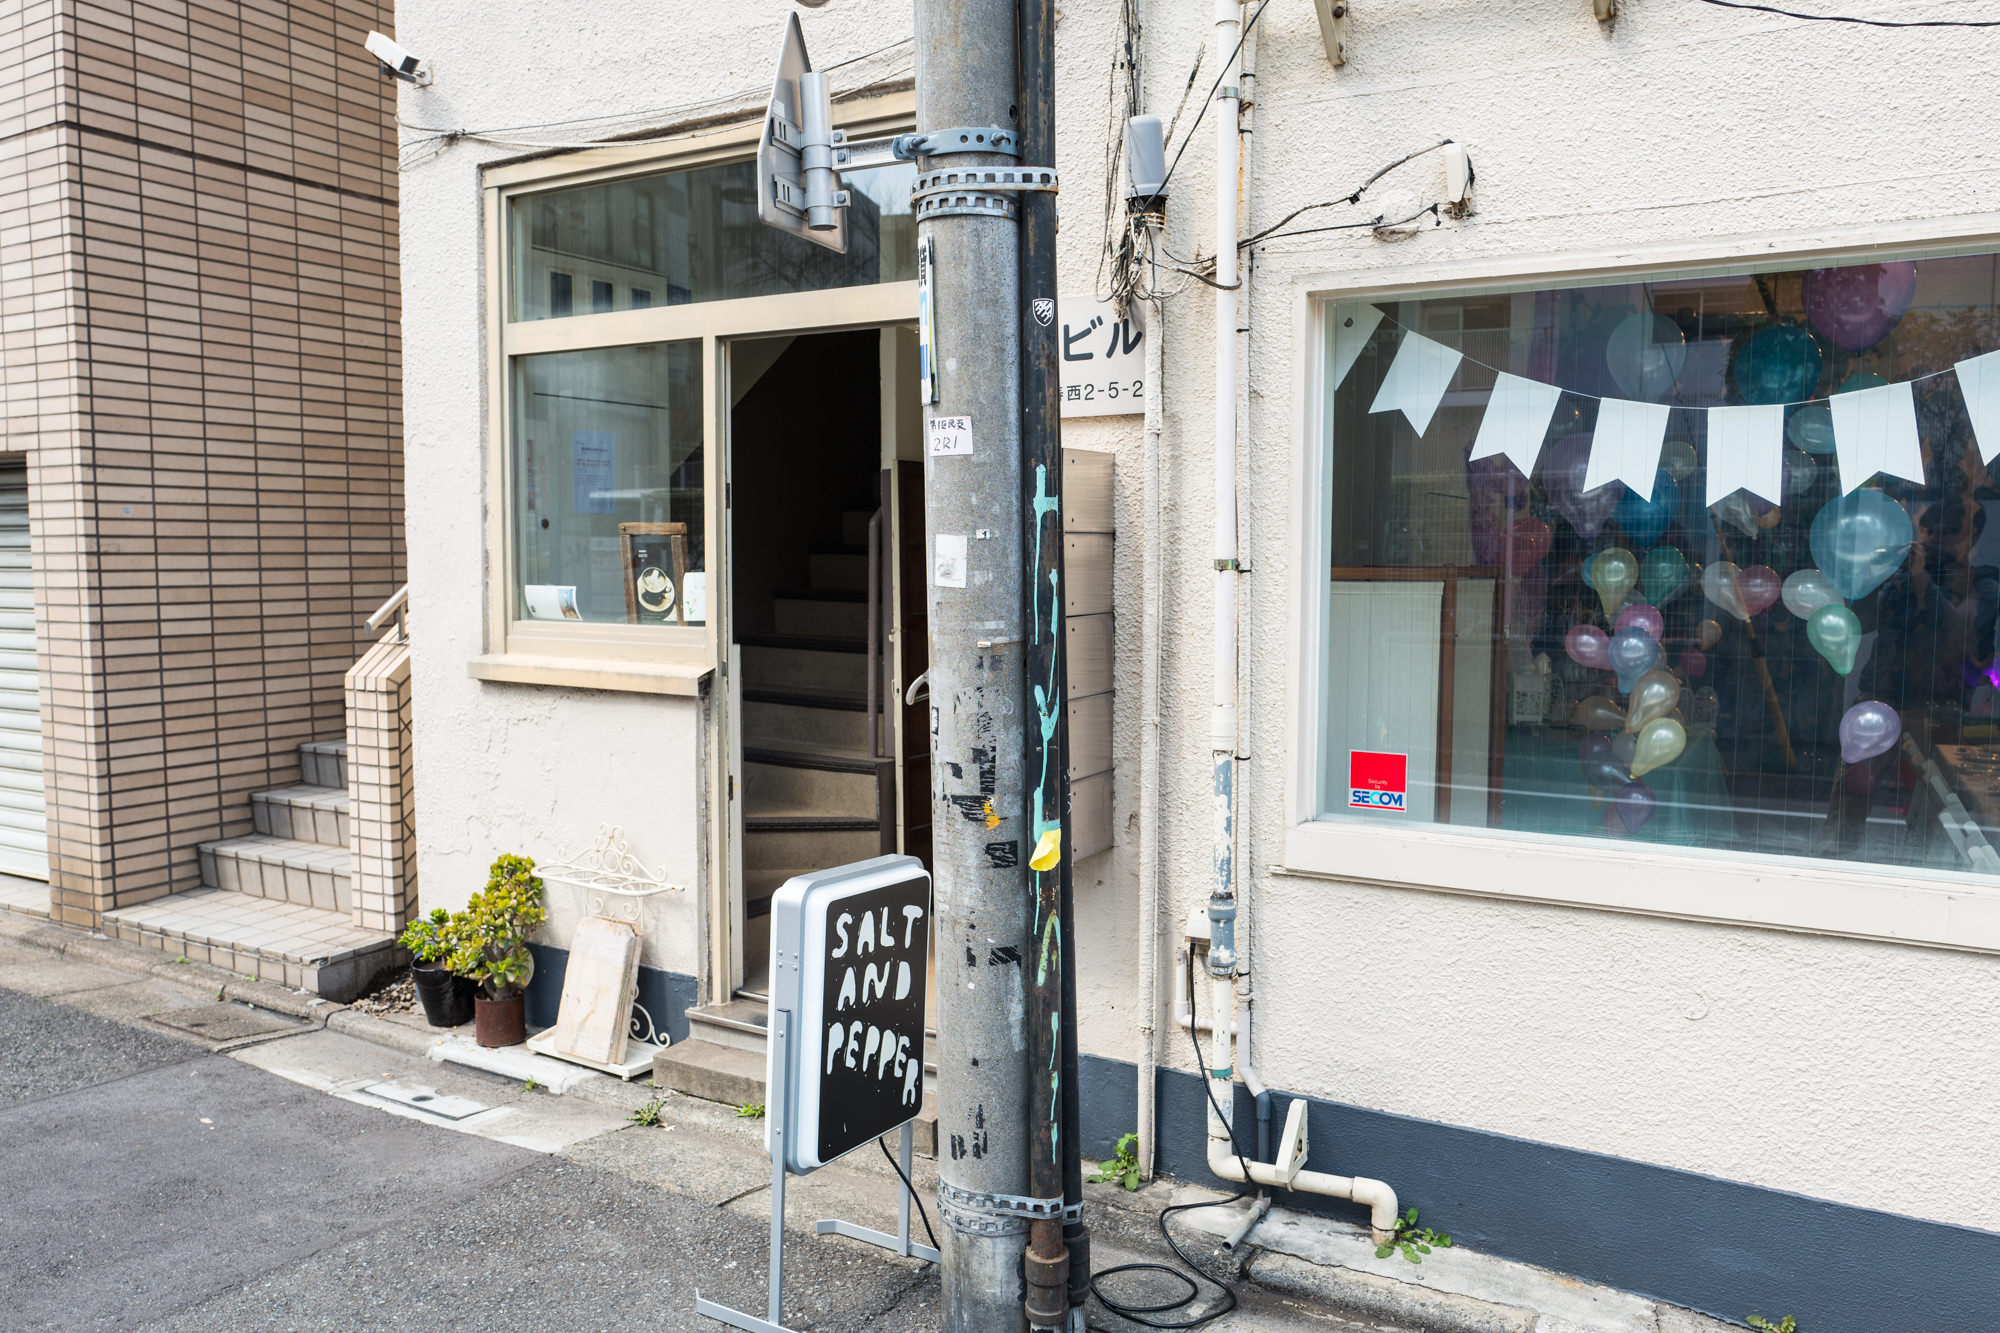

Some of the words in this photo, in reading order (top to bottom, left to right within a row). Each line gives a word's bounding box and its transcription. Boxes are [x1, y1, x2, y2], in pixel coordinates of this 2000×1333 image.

[1063, 315, 1143, 362] ビル
[1352, 790, 1403, 807] SECOM
[1368, 778, 1388, 786] Security
[832, 905, 924, 959] SALT
[837, 961, 912, 1011] AND
[826, 1020, 919, 1106] PEPPER
